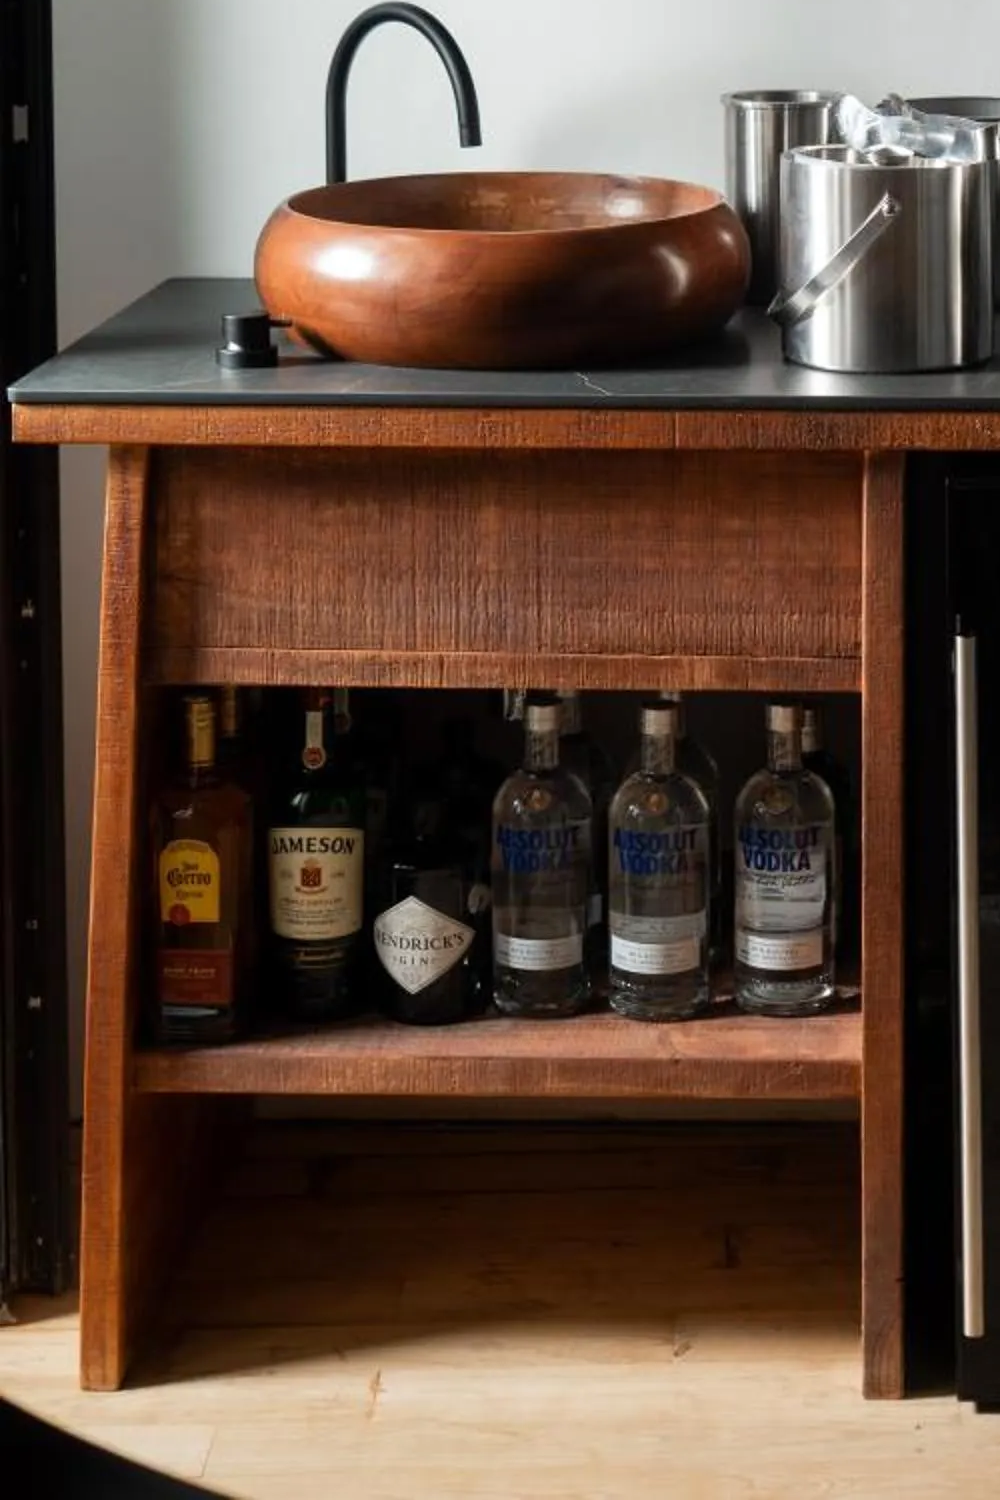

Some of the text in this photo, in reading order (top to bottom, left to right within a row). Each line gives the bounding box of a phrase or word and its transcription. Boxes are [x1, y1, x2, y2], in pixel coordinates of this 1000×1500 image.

[271, 836, 356, 855] JAMESON
[744, 848, 811, 872] VODKA
[399, 956, 429, 966] GIN
